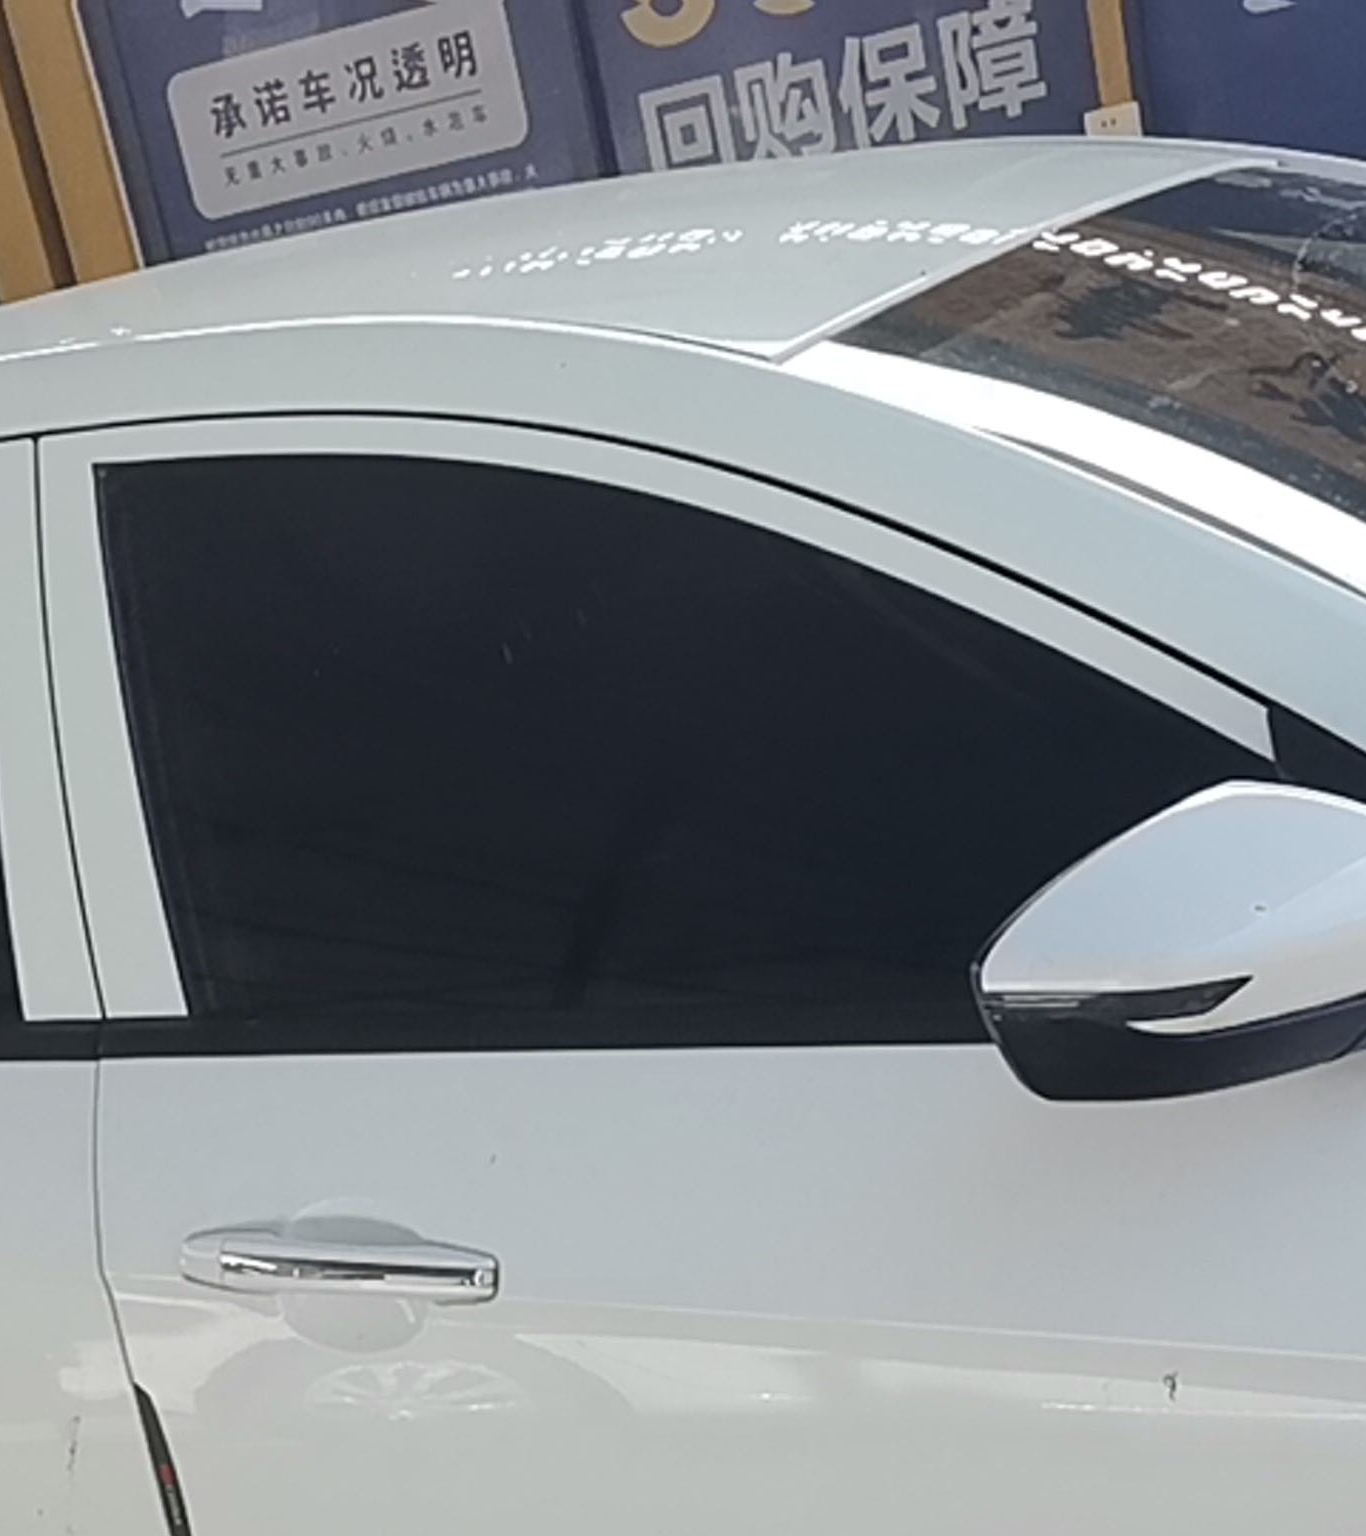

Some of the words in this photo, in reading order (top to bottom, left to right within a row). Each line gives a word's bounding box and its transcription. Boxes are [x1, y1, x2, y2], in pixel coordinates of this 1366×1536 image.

[210, 31, 478, 139] 承诺车况透明
[638, 0, 1048, 171] 回购保障
